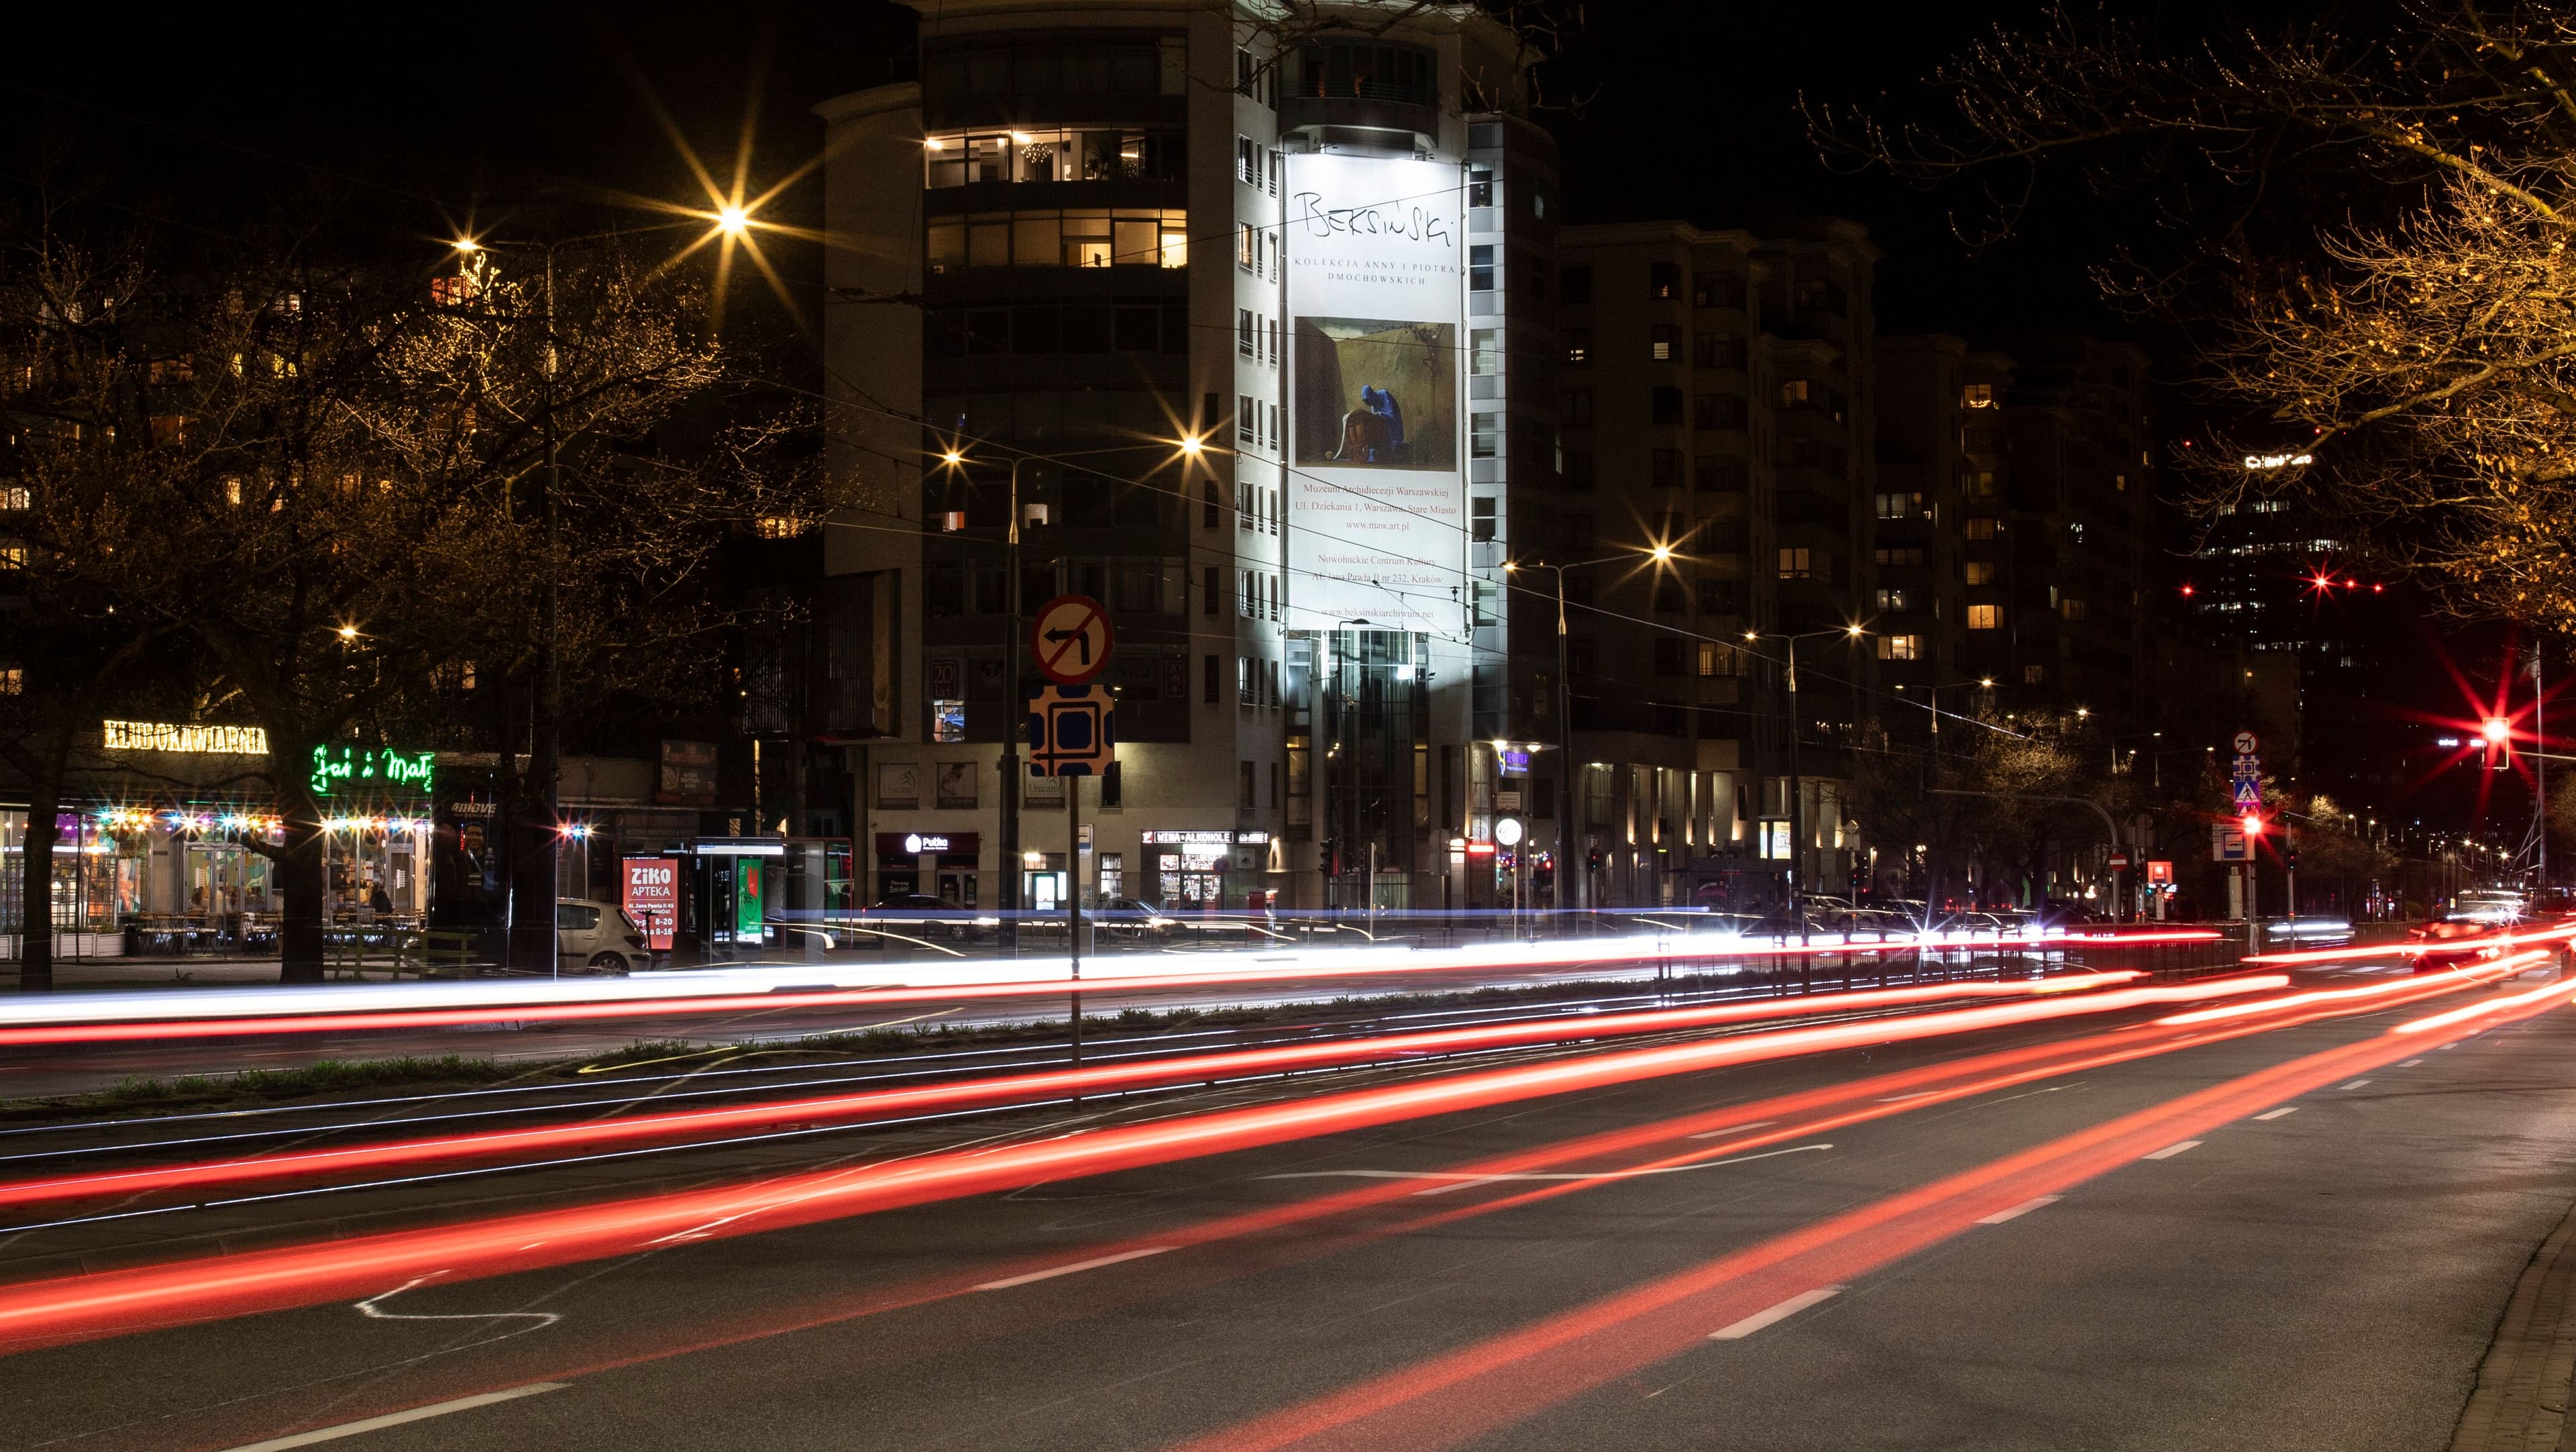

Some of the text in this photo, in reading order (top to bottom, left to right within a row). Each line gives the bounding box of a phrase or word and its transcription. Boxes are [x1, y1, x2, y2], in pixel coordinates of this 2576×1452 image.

[1295, 258, 1358, 268] KOLEKCJA
[1364, 262, 1396, 270] ANNY
[1413, 264, 1455, 273] PIOTRA
[1328, 272, 1426, 285] DMOCHOWSKICH
[1303, 484, 1448, 499] Muzeum Archidiecezji Warszawskiej
[1295, 503, 1307, 511] Ul.
[1311, 503, 1352, 511] Dziekania
[1408, 505, 1428, 514] Stare
[1430, 505, 1456, 515] Miasto
[1346, 521, 1409, 532] www.maw.art.pl
[1318, 555, 1437, 568] Nowohuckie Centrum Kultury
[1326, 573, 1346, 581] Jana
[1347, 574, 1371, 582] Pawła
[1411, 574, 1442, 584] Kraków
[103, 720, 269, 754] KLUBOKAWIARNIA
[362, 751, 374, 778] i
[922, 837, 948, 847] Putka
[1157, 833, 1181, 842] WINA
[1185, 833, 1230, 842] ALKOHOLE
[632, 887, 670, 896] APTEKA
